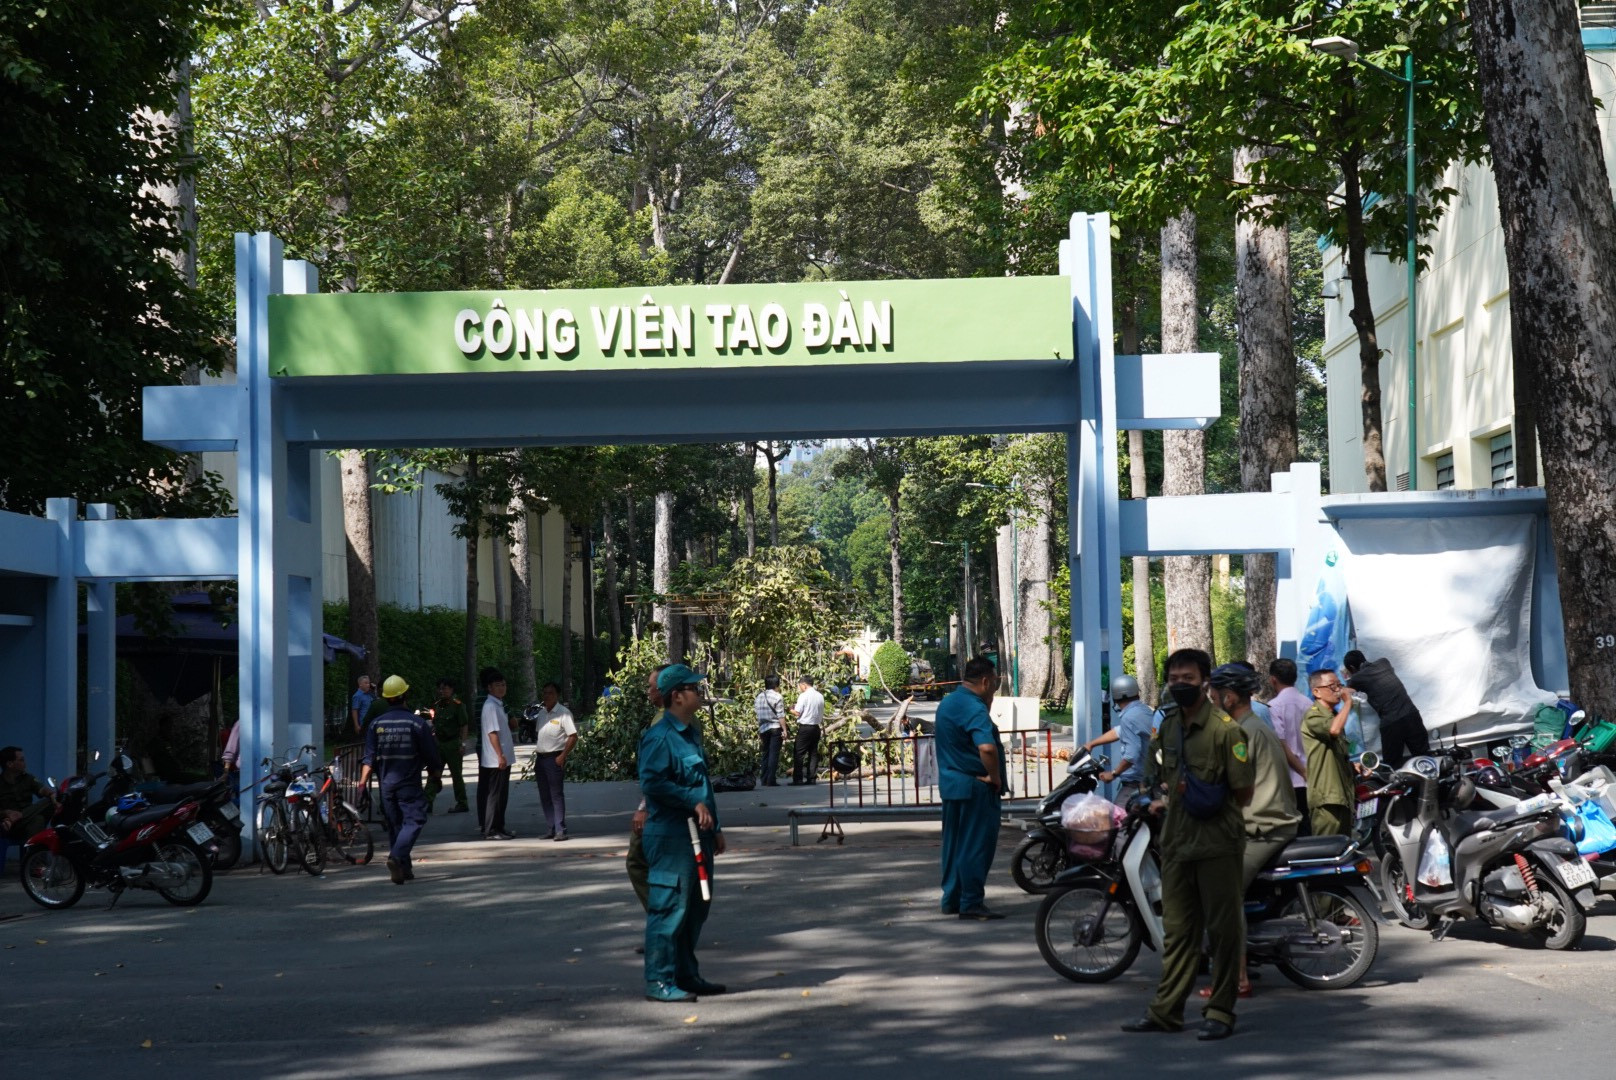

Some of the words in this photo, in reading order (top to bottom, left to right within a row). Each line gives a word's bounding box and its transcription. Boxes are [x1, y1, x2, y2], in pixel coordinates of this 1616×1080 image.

[454, 297, 577, 356] CÔNG
[589, 293, 693, 352] VIÊN
[705, 303, 790, 350] TAO
[801, 289, 892, 348] ĐÀN
[1595, 634, 1615, 649] 39
